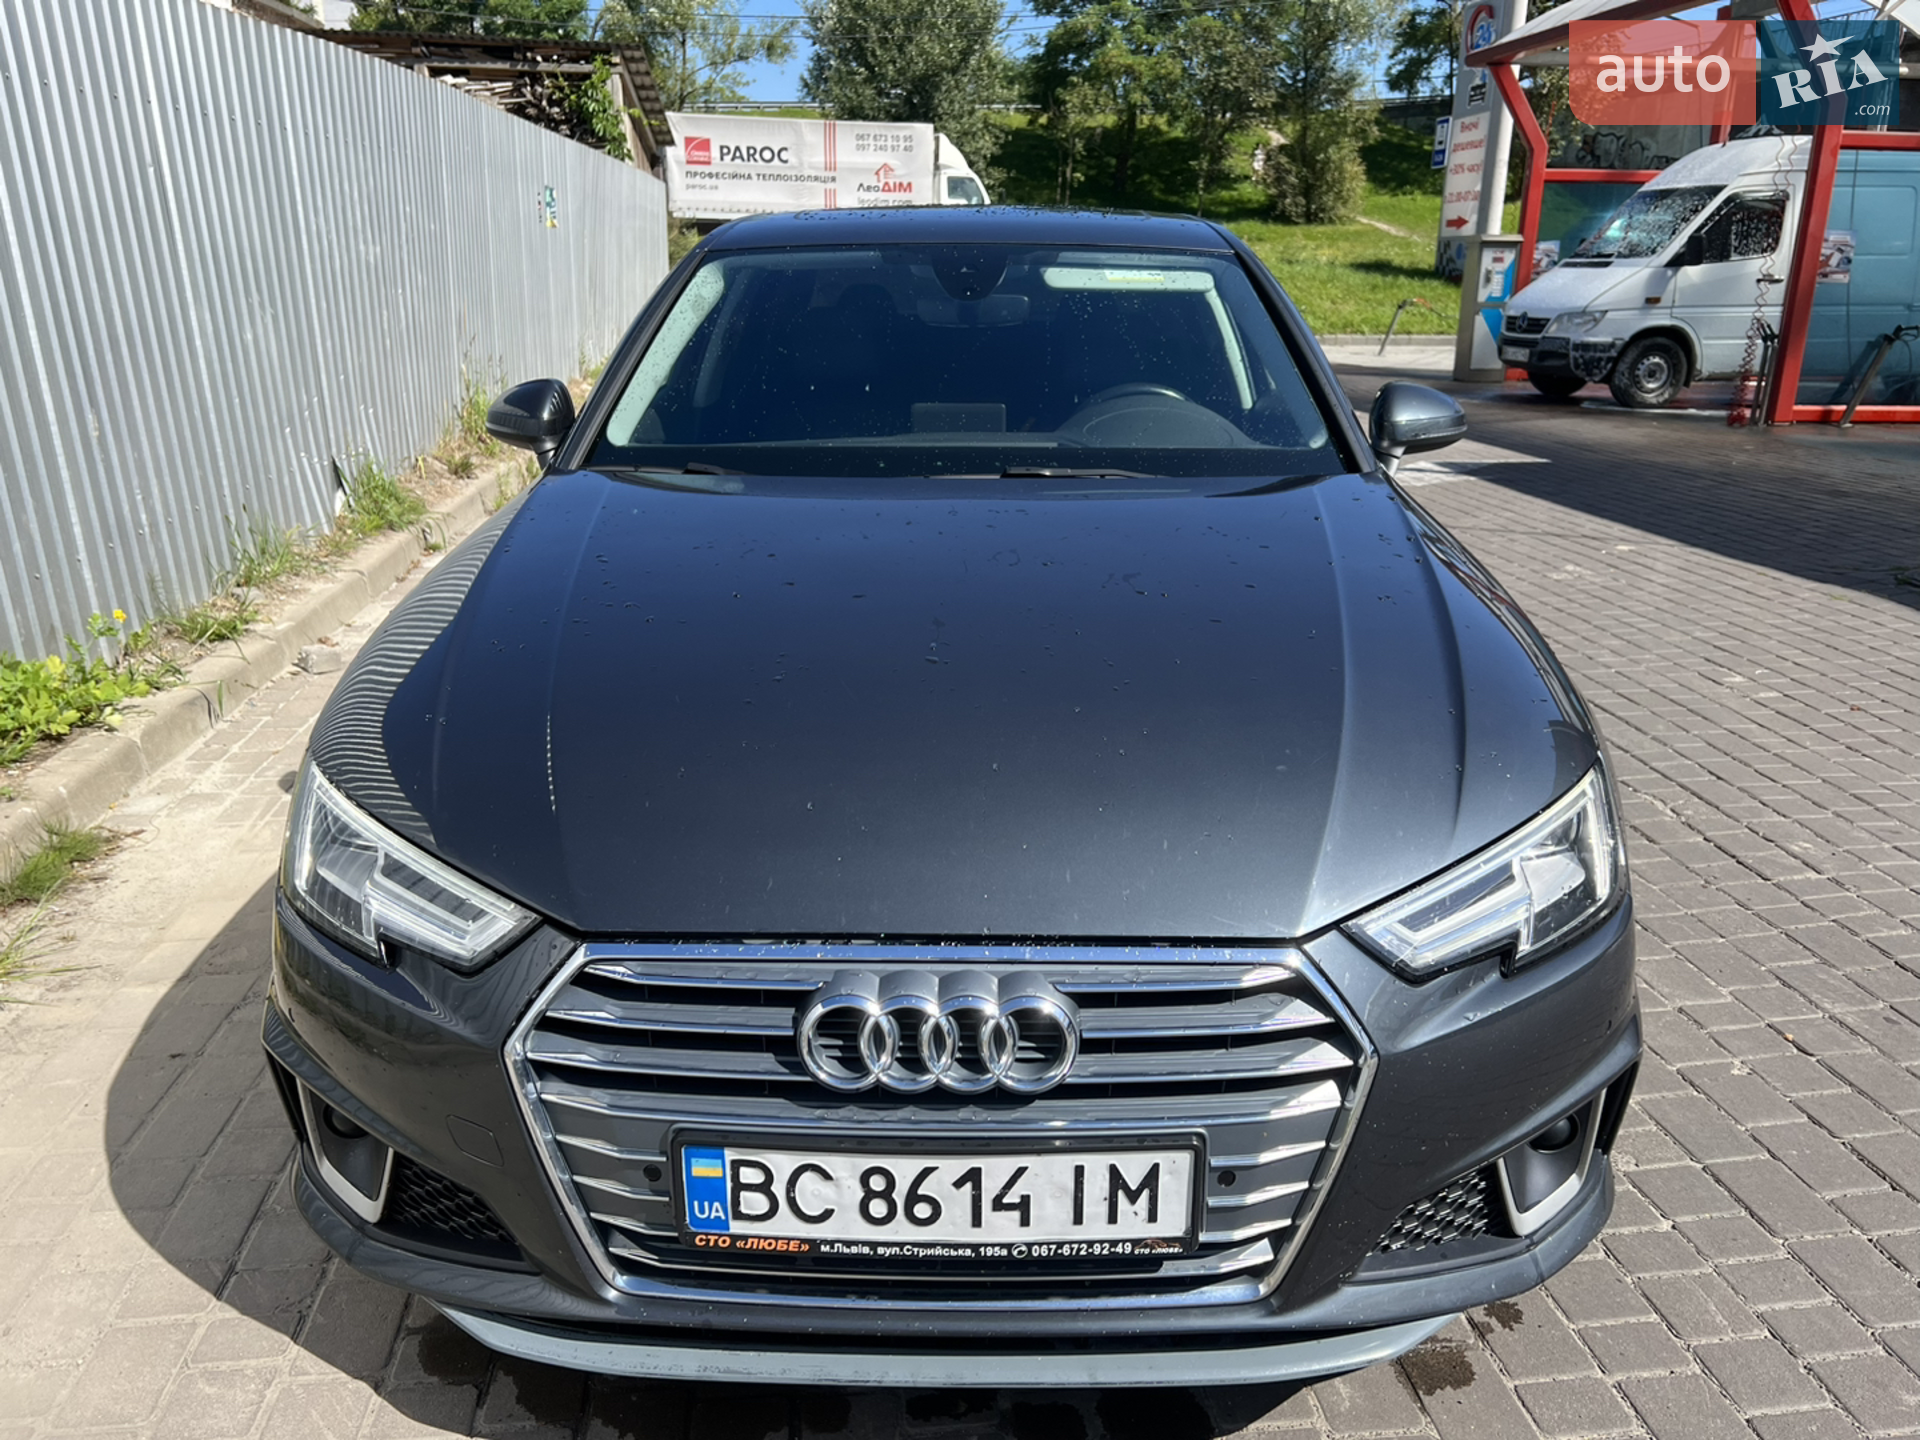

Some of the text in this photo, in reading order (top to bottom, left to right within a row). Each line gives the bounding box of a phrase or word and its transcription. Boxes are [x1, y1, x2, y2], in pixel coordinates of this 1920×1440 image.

[855, 133, 914, 143] 067 673 10 95
[719, 144, 789, 164] PAROC
[855, 143, 914, 153] 097 240 97 40
[685, 170, 837, 183] ПРОФЕСІЙНА ТЕПЛОІЗОЛЯЦІЯ
[856, 181, 913, 193] ЛеоДІМ
[730, 1158, 1161, 1229] BC 8614 IM
[693, 1200, 726, 1220] UA
[695, 1234, 811, 1253] СТО «ЛЮБЕ»
[820, 1242, 1133, 1257] м.Львів, вул.Стрийська, 195а 067-672-92-49
